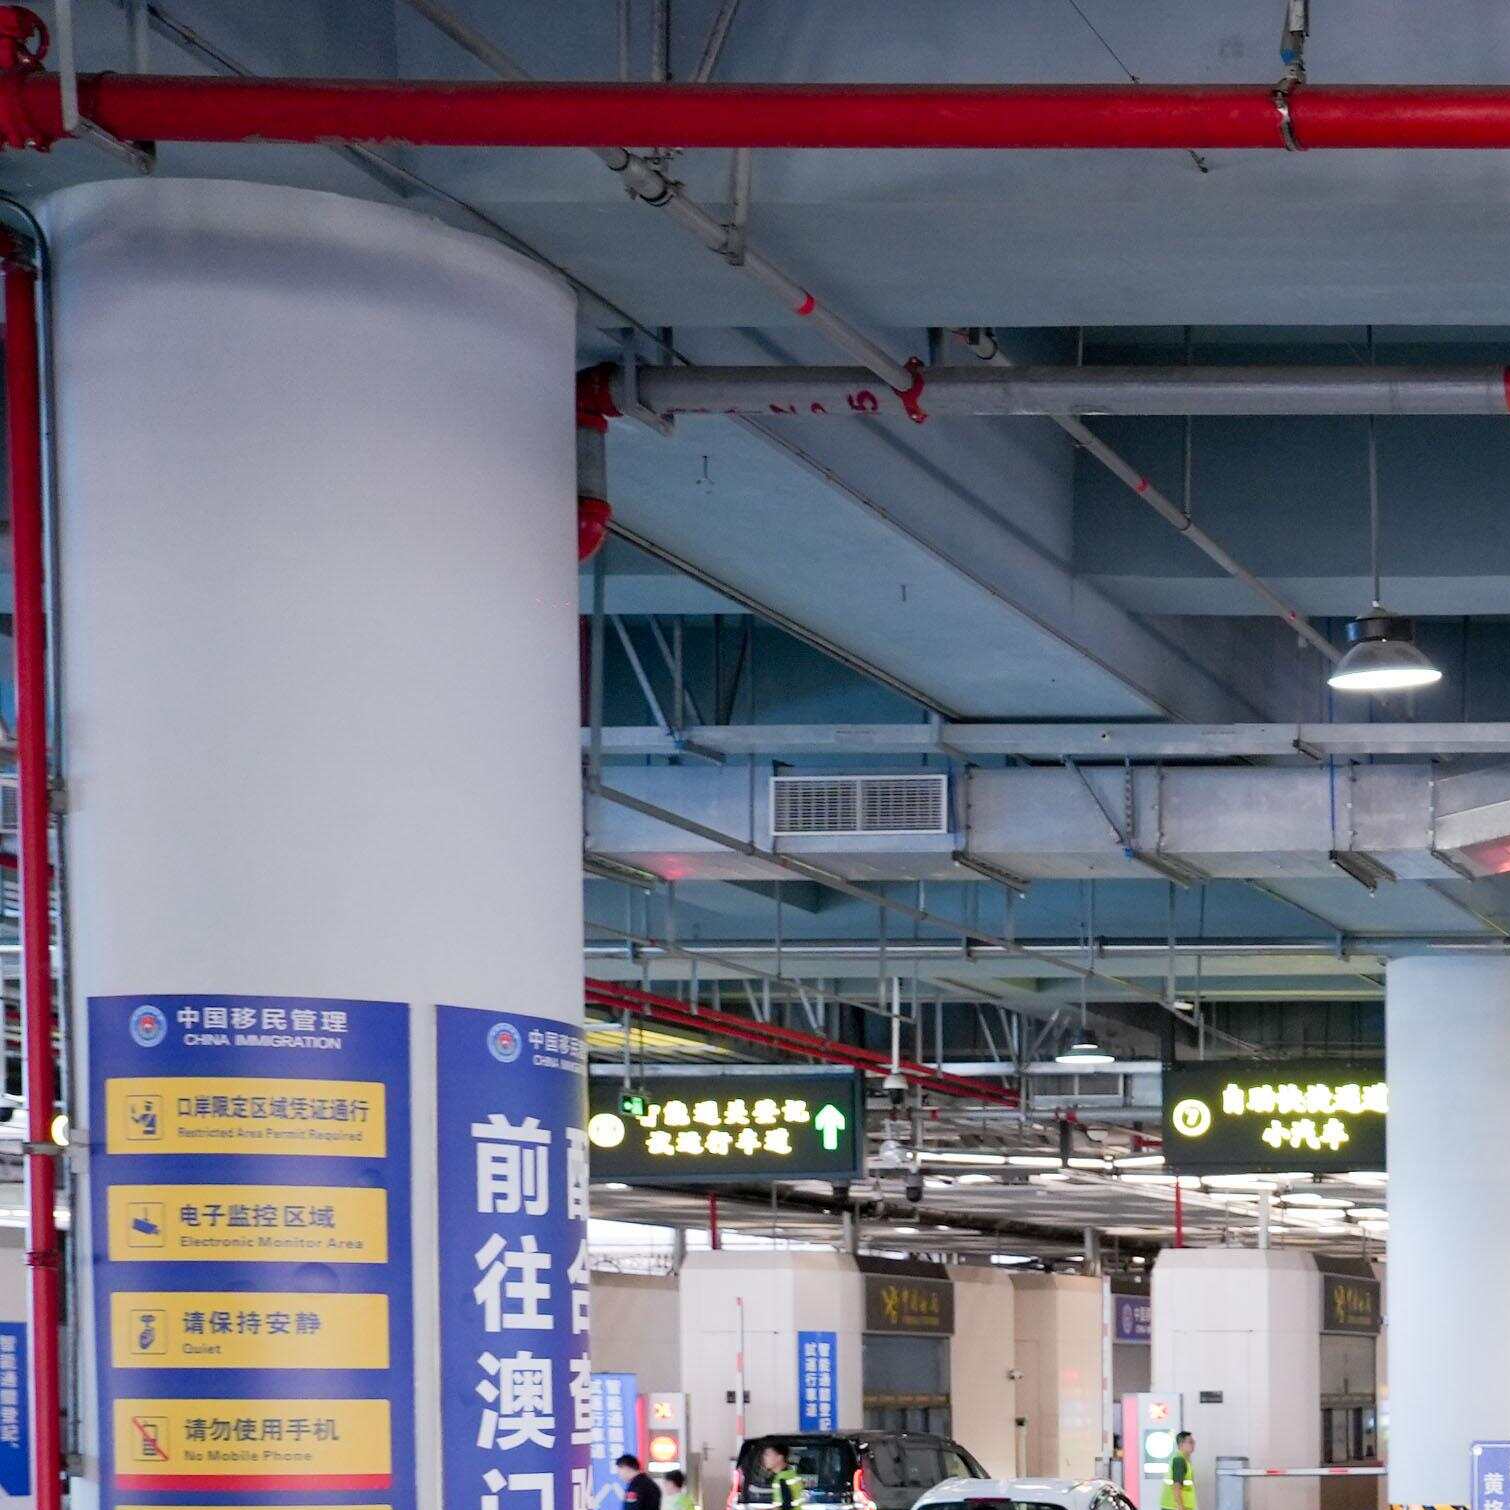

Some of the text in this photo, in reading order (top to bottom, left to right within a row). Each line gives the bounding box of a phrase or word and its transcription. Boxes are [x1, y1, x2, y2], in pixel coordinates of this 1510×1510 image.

[176, 1006, 348, 1033] 中国移民管理
[183, 1034, 342, 1050] CHINA IMMIGRATION
[180, 1204, 336, 1229] 电子监控区域
[180, 1236, 364, 1250] Electronic Monitor Area
[182, 1311, 322, 1335] 请保持安静
[182, 1343, 221, 1355] Quiet
[184, 1418, 340, 1442] 请勿使用手机
[184, 1450, 314, 1462] No Mobile Phone
